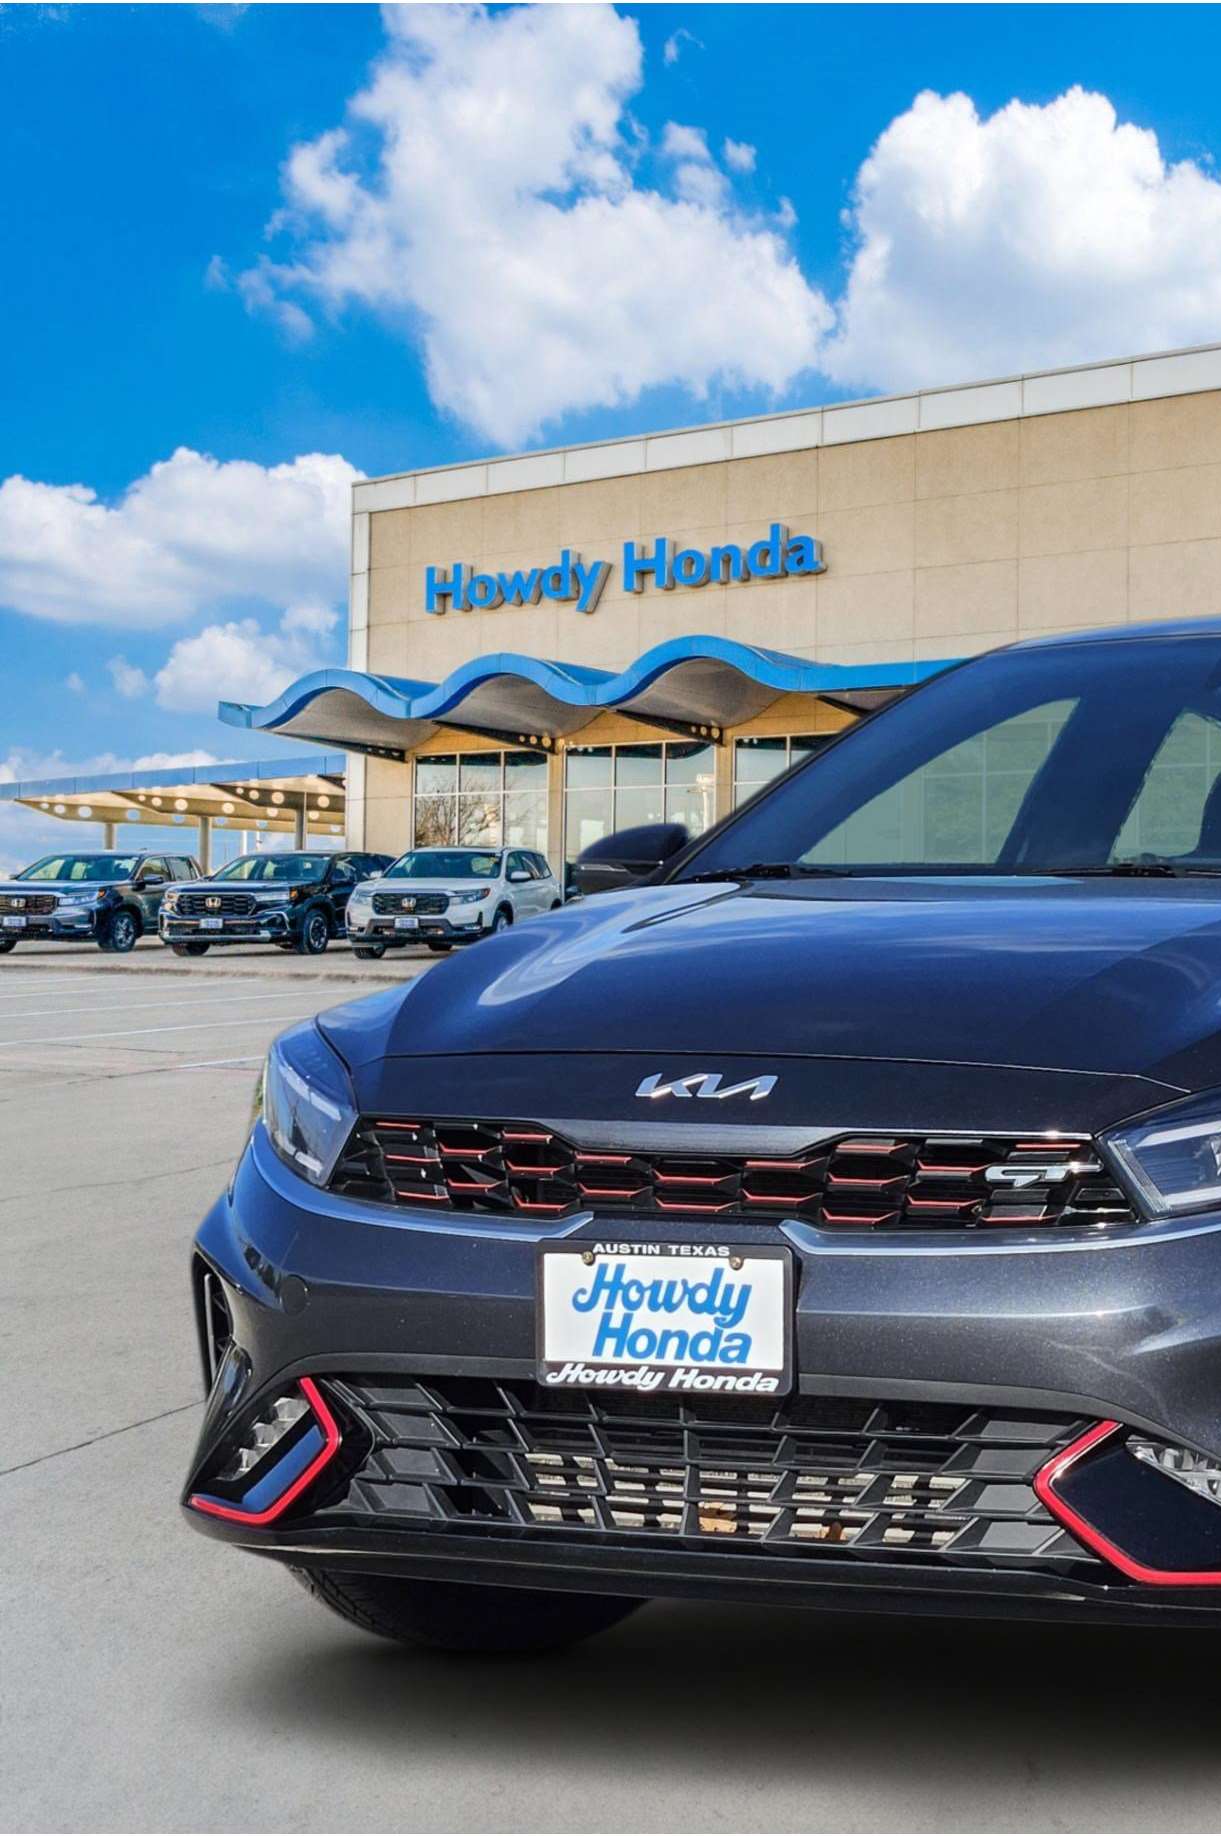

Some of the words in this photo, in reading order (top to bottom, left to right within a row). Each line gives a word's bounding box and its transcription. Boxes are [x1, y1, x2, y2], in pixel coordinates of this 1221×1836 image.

[425, 548, 611, 614] Howdy
[623, 523, 826, 593] Honda
[635, 1073, 778, 1100] KIA
[592, 1243, 661, 1255] AUSTIN
[668, 1245, 730, 1257] TEXAS
[572, 1263, 752, 1328] Howdy
[592, 1312, 752, 1363] Honda
[546, 1363, 665, 1391] Howdy
[669, 1368, 780, 1392] Honda
